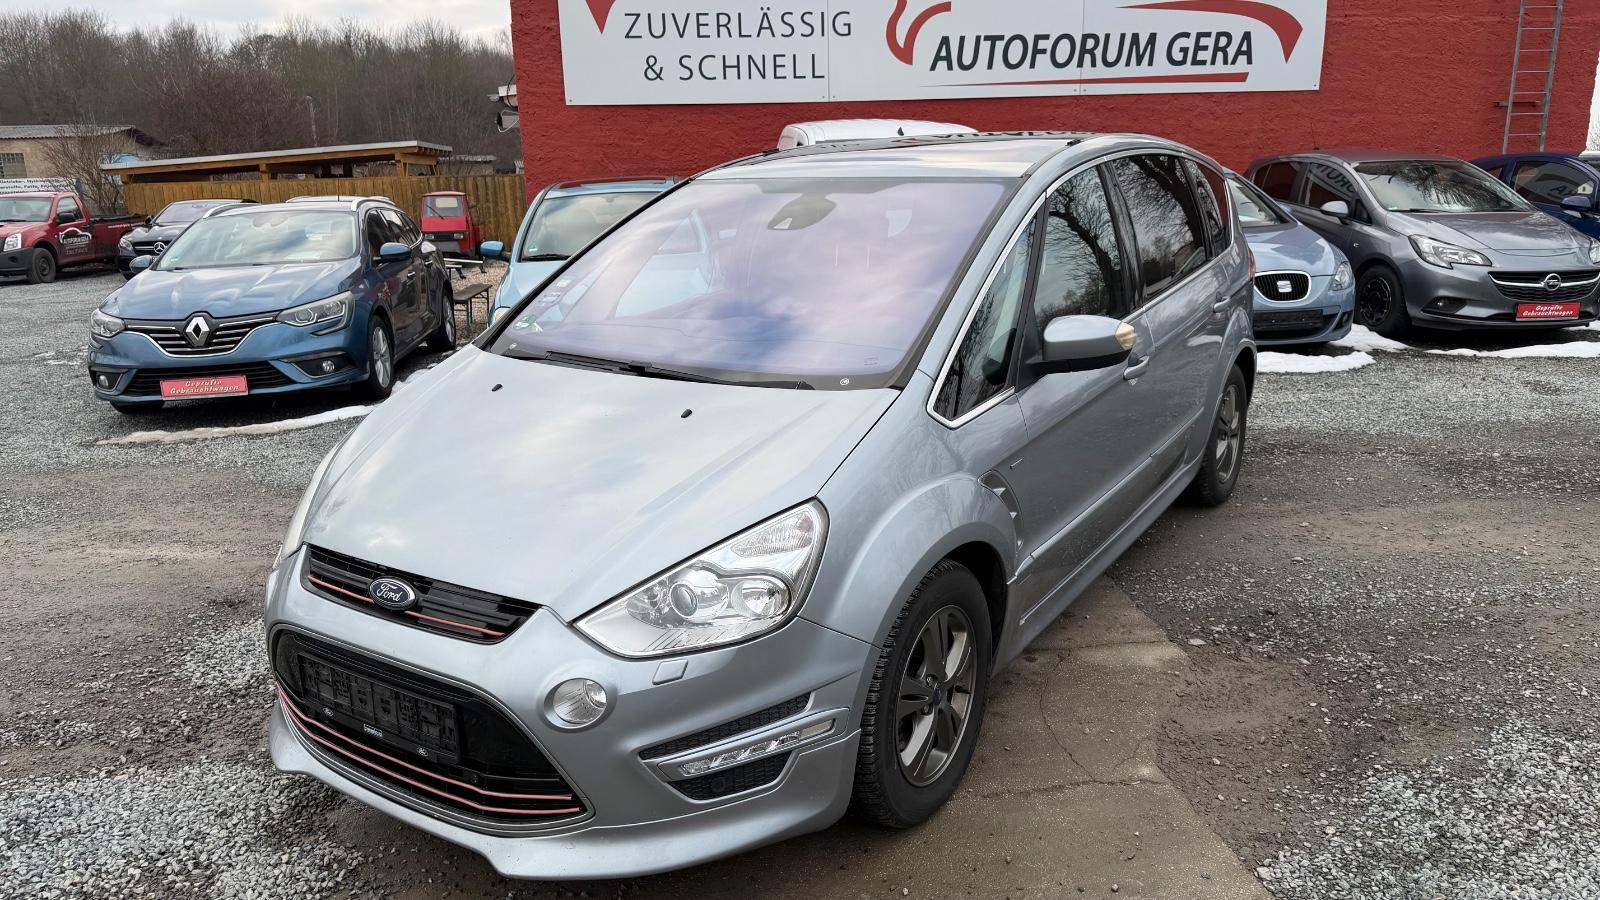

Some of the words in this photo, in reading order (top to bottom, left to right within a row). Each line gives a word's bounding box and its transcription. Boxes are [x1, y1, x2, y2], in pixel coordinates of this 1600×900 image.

[624, 7, 852, 40] ZUVERLÄSSIG
[930, 32, 1155, 72] AUTOFORUM
[1166, 30, 1254, 67] GERA
[643, 55, 664, 81] &
[678, 53, 826, 80] SCHNELL
[377, 583, 403, 601] Ford
